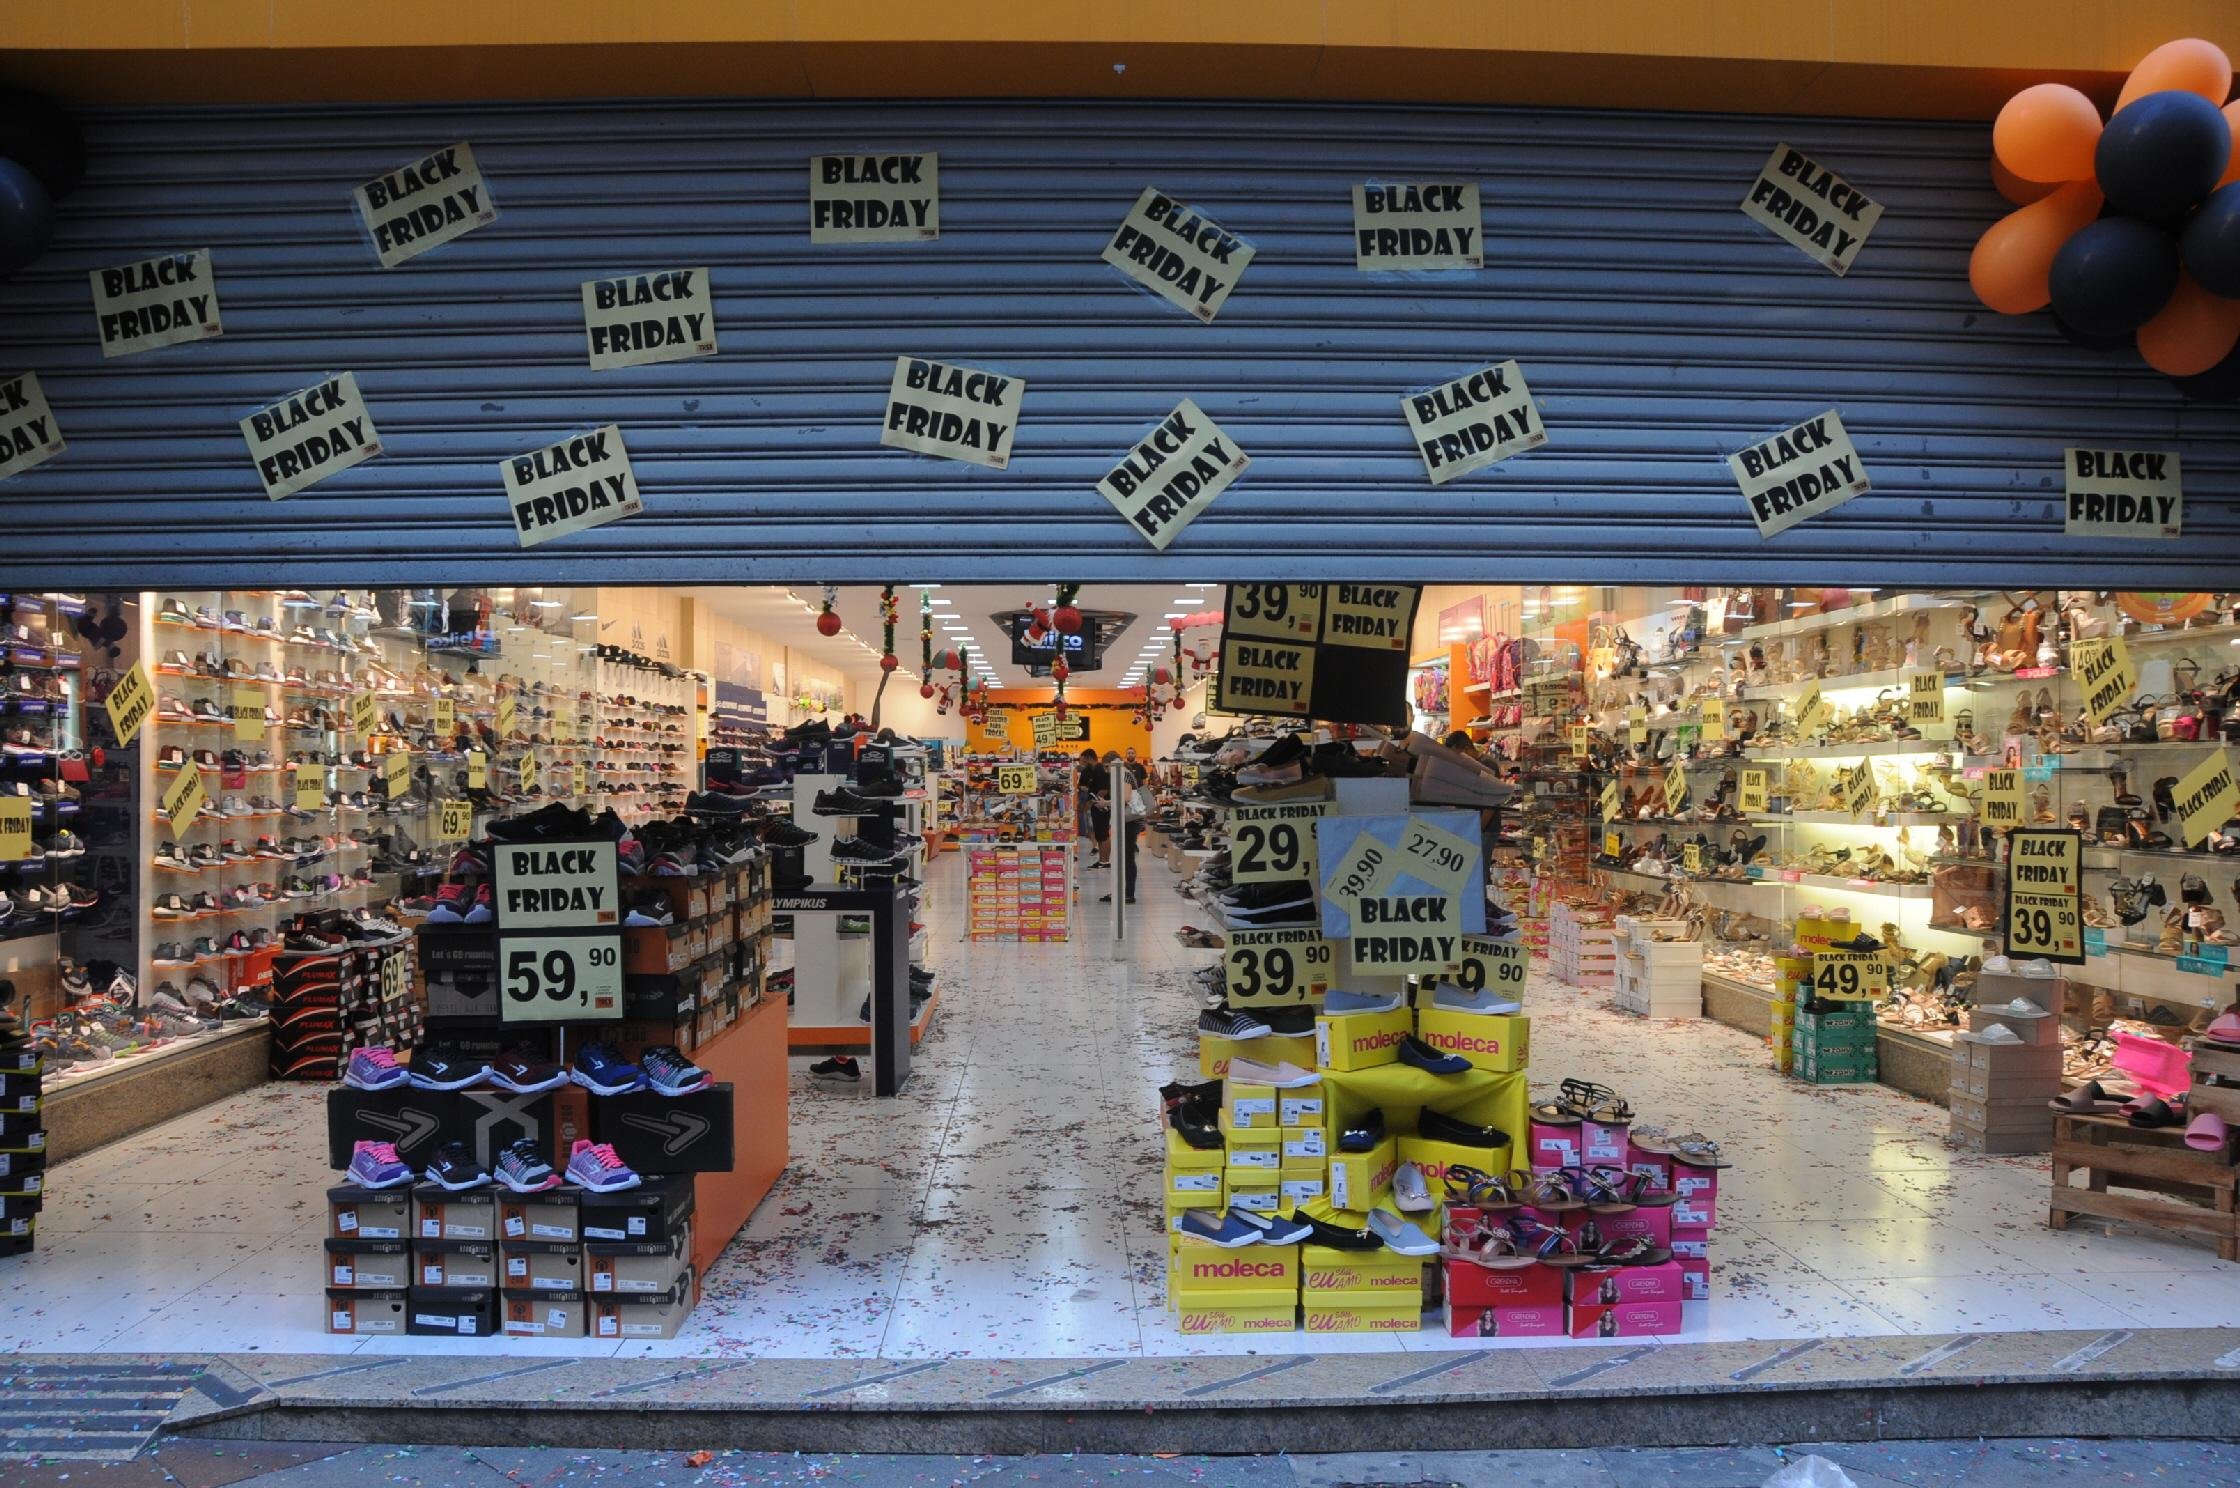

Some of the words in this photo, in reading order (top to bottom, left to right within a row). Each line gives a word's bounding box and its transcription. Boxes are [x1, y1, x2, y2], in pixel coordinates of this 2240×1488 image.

[364, 148, 462, 209] BLACK
[822, 156, 921, 185] BLACK
[1778, 149, 1875, 221] BLACK
[814, 198, 931, 229] FRIDAY
[1364, 186, 1464, 213] BLACK
[373, 185, 480, 254] FRIDAY
[1144, 194, 1241, 264] BLACK
[1752, 179, 1857, 259] FRIDAY
[1359, 227, 1474, 256] FRIDAY
[101, 255, 197, 298] BLACK
[1113, 226, 1224, 304] FRIDAY
[594, 271, 694, 309] BLACK
[101, 295, 209, 342] FRIDAY
[590, 313, 705, 355] FRIDAY
[907, 361, 1009, 407] BLACK
[1412, 368, 1511, 425] BLACK
[254, 380, 346, 442] BLACK
[889, 401, 1007, 452] FRIDAY
[0, 416, 51, 464] DAY
[1422, 405, 1531, 468] FRIDAY
[1738, 417, 1831, 478] BLACK
[260, 419, 365, 486] FRIDAY
[513, 433, 611, 486] BLACK
[1107, 412, 1196, 500] BLACK
[2076, 451, 2167, 481] BLACK
[1133, 436, 1232, 536] FRIDAY
[1752, 455, 1859, 523] FRIDAY
[516, 473, 627, 531] FRIDAY
[2069, 493, 2175, 524] FRIDAY
[1300, 584, 1318, 599] 90
[1338, 586, 1400, 608] BLACK
[1332, 613, 1399, 637] FRIDAY
[1238, 647, 1302, 670] BLACK
[2084, 645, 2116, 686] BLACK
[112, 671, 138, 711] BLACK
[1230, 675, 1302, 700] FRIDAY
[1915, 675, 1937, 692] BLACK
[2090, 670, 2126, 716] FRIDAY
[119, 694, 148, 737] FRIDAY
[234, 705, 248, 719] BLACK
[249, 707, 264, 720] FRIDAY
[1913, 701, 1939, 719] FRIDAY
[1848, 764, 1866, 794] BLACK
[1989, 773, 2014, 790] BLACK
[1852, 784, 1872, 818] FRIDAY
[1987, 802, 2017, 819] FRIDAY
[2177, 791, 2205, 823] BLACK
[2203, 767, 2232, 804] FRIDAY
[1236, 806, 1276, 820] BLACK
[1280, 804, 1326, 819] FRIDAY
[512, 850, 596, 875] BLACK
[2021, 840, 2066, 857] BLACK
[2017, 865, 2068, 883] FRIDAY
[507, 887, 604, 913] FRIDAY
[772, 898, 828, 908] LYMPIKUS
[1360, 897, 1446, 923] BLACK
[2015, 895, 2038, 906] BLACK
[2040, 897, 2069, 908] FRIDAY
[1232, 932, 1273, 946] BLACK
[1276, 930, 1322, 944] FRIDAY
[2013, 908, 2059, 952] 39,
[2058, 911, 2075, 926] 90
[1354, 936, 1454, 964] FRIDAY
[1472, 942, 1519, 960] FRIDAY
[1848, 953, 1879, 961] FRIDAY
[508, 950, 588, 1007] 59,
[589, 948, 616, 966] 90
[1231, 948, 1305, 1001] 39,
[1306, 946, 1330, 964] 90
[1499, 963, 1523, 982] 90
[1817, 964, 1866, 998] 49,
[1867, 964, 1883, 975] 90
[1353, 1029, 1409, 1053] moleca
[1424, 1031, 1499, 1055] moleca
[1193, 1259, 1284, 1277] moleca
[1371, 1275, 1418, 1286] moleca
[1244, 1317, 1291, 1328] moleca
[1370, 1318, 1418, 1328] moleca
